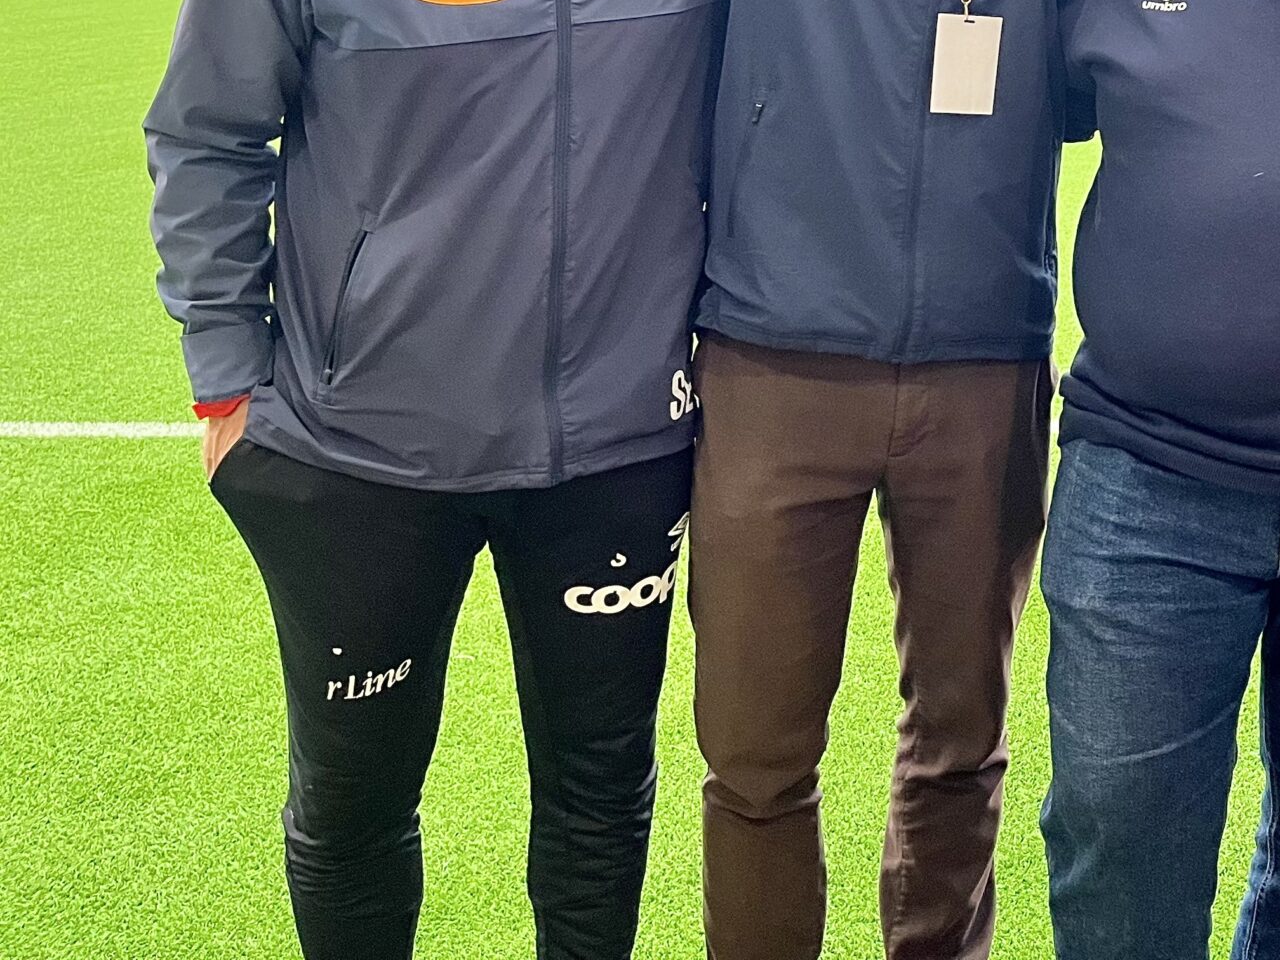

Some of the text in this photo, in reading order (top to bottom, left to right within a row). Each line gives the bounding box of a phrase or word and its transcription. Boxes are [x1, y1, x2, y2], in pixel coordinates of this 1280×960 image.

[1142, 0, 1187, 11] umbro
[563, 560, 678, 614] coop
[343, 658, 412, 700] Line
